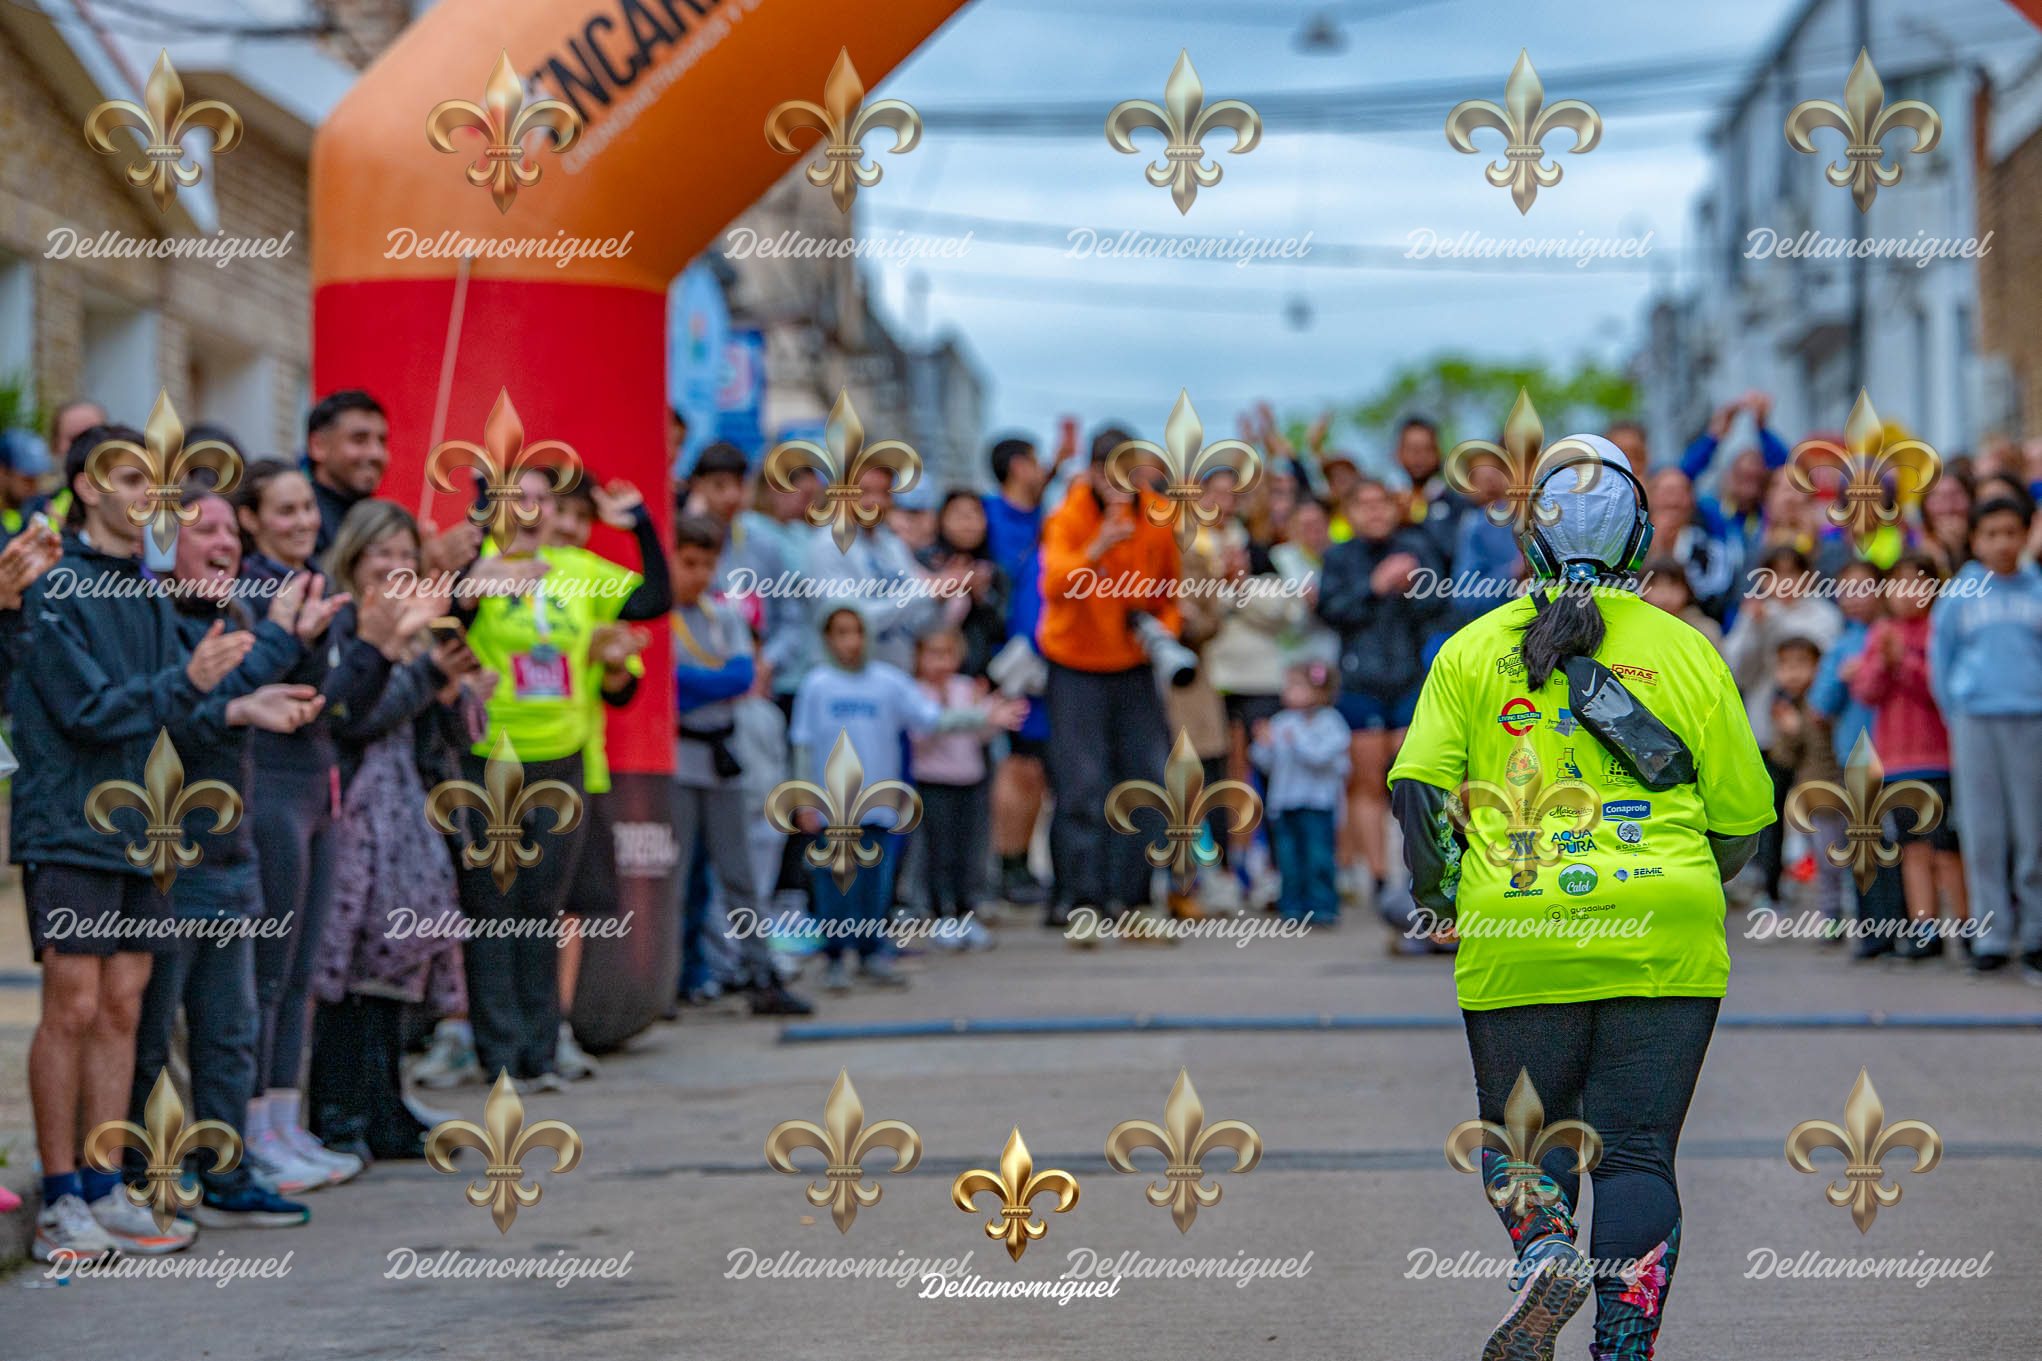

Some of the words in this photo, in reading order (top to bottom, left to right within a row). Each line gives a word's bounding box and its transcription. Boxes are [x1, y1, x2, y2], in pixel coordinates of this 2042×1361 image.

[1606, 804, 1648, 814] Conaprole
[1551, 829, 1593, 842] AQUA
[1558, 839, 1597, 854] PURA
